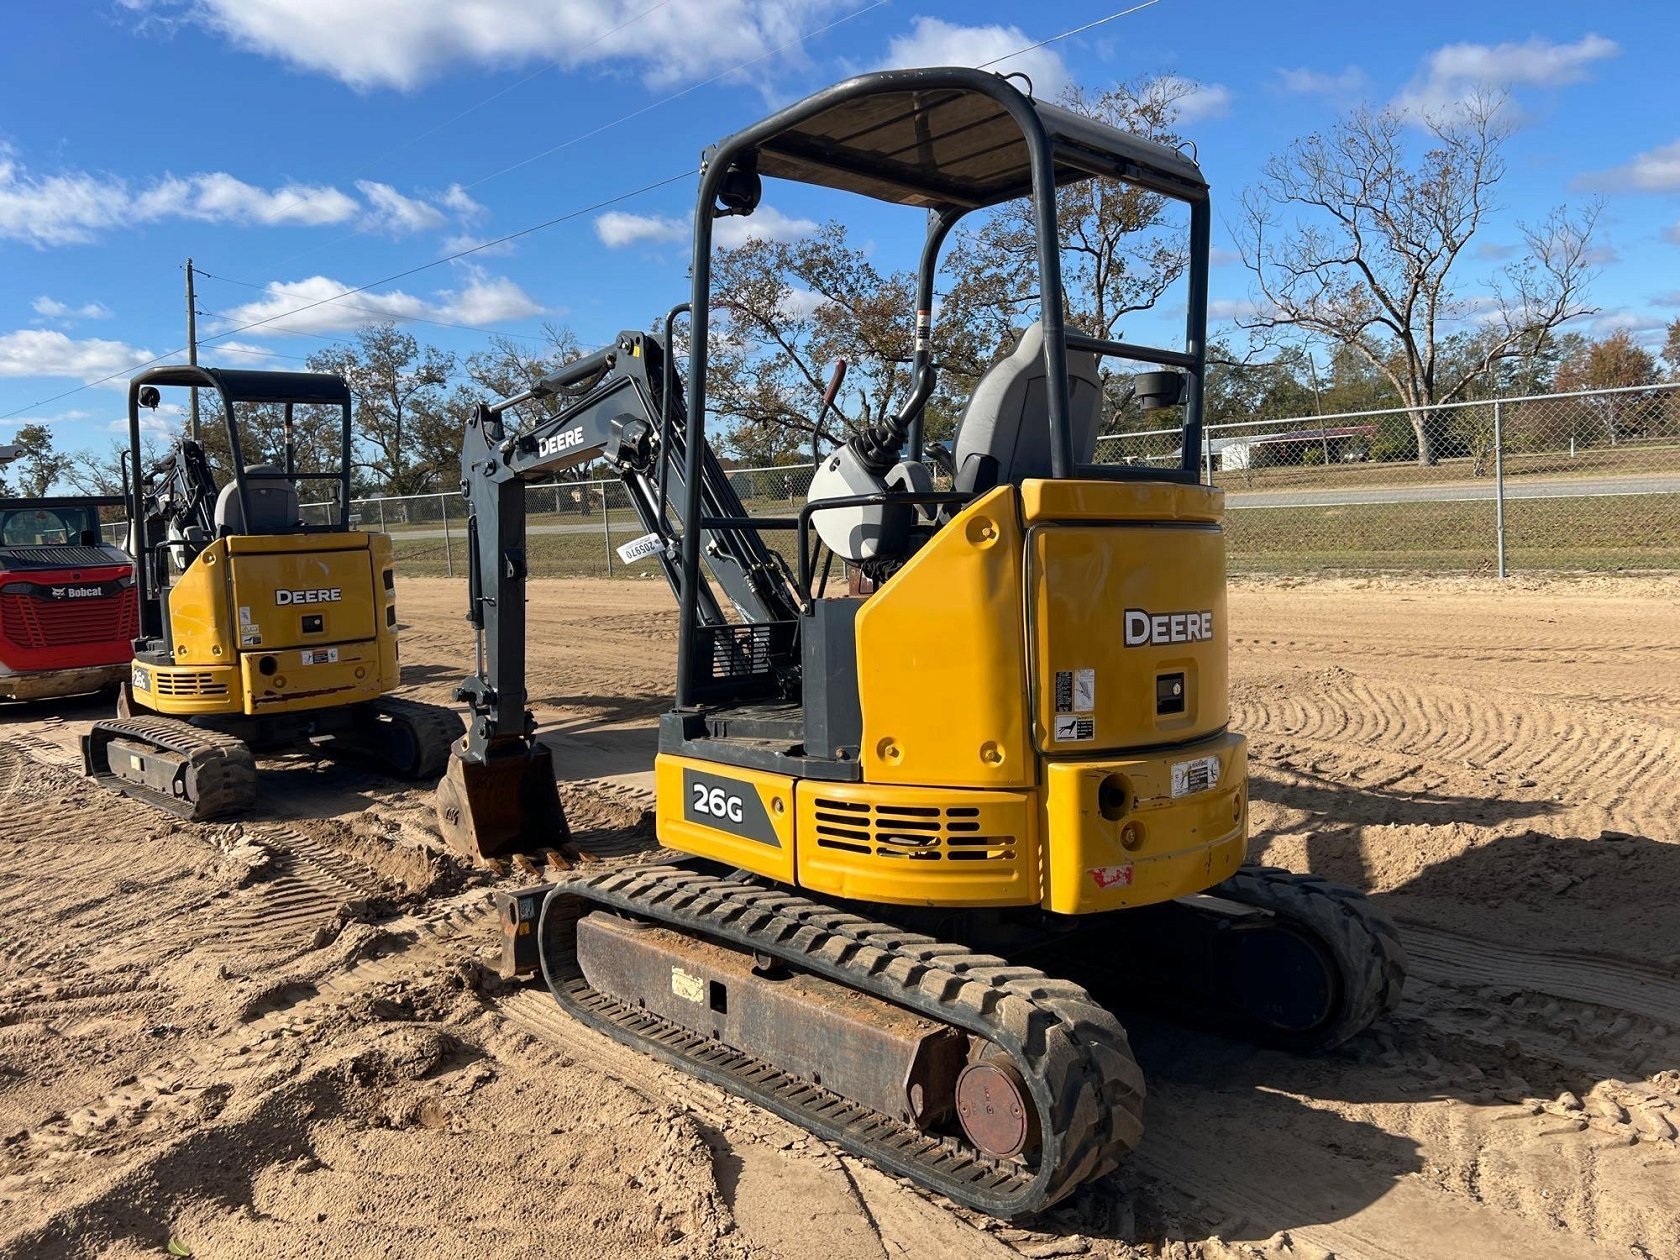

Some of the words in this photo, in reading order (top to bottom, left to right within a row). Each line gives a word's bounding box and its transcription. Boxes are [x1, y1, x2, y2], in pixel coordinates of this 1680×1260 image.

[538, 426, 584, 458] DEERE
[625, 541, 656, 559] 205970
[68, 587, 102, 598] Bobcat
[276, 588, 342, 605] DEERE
[1124, 609, 1212, 646] DEERE
[693, 782, 743, 823] 26G
